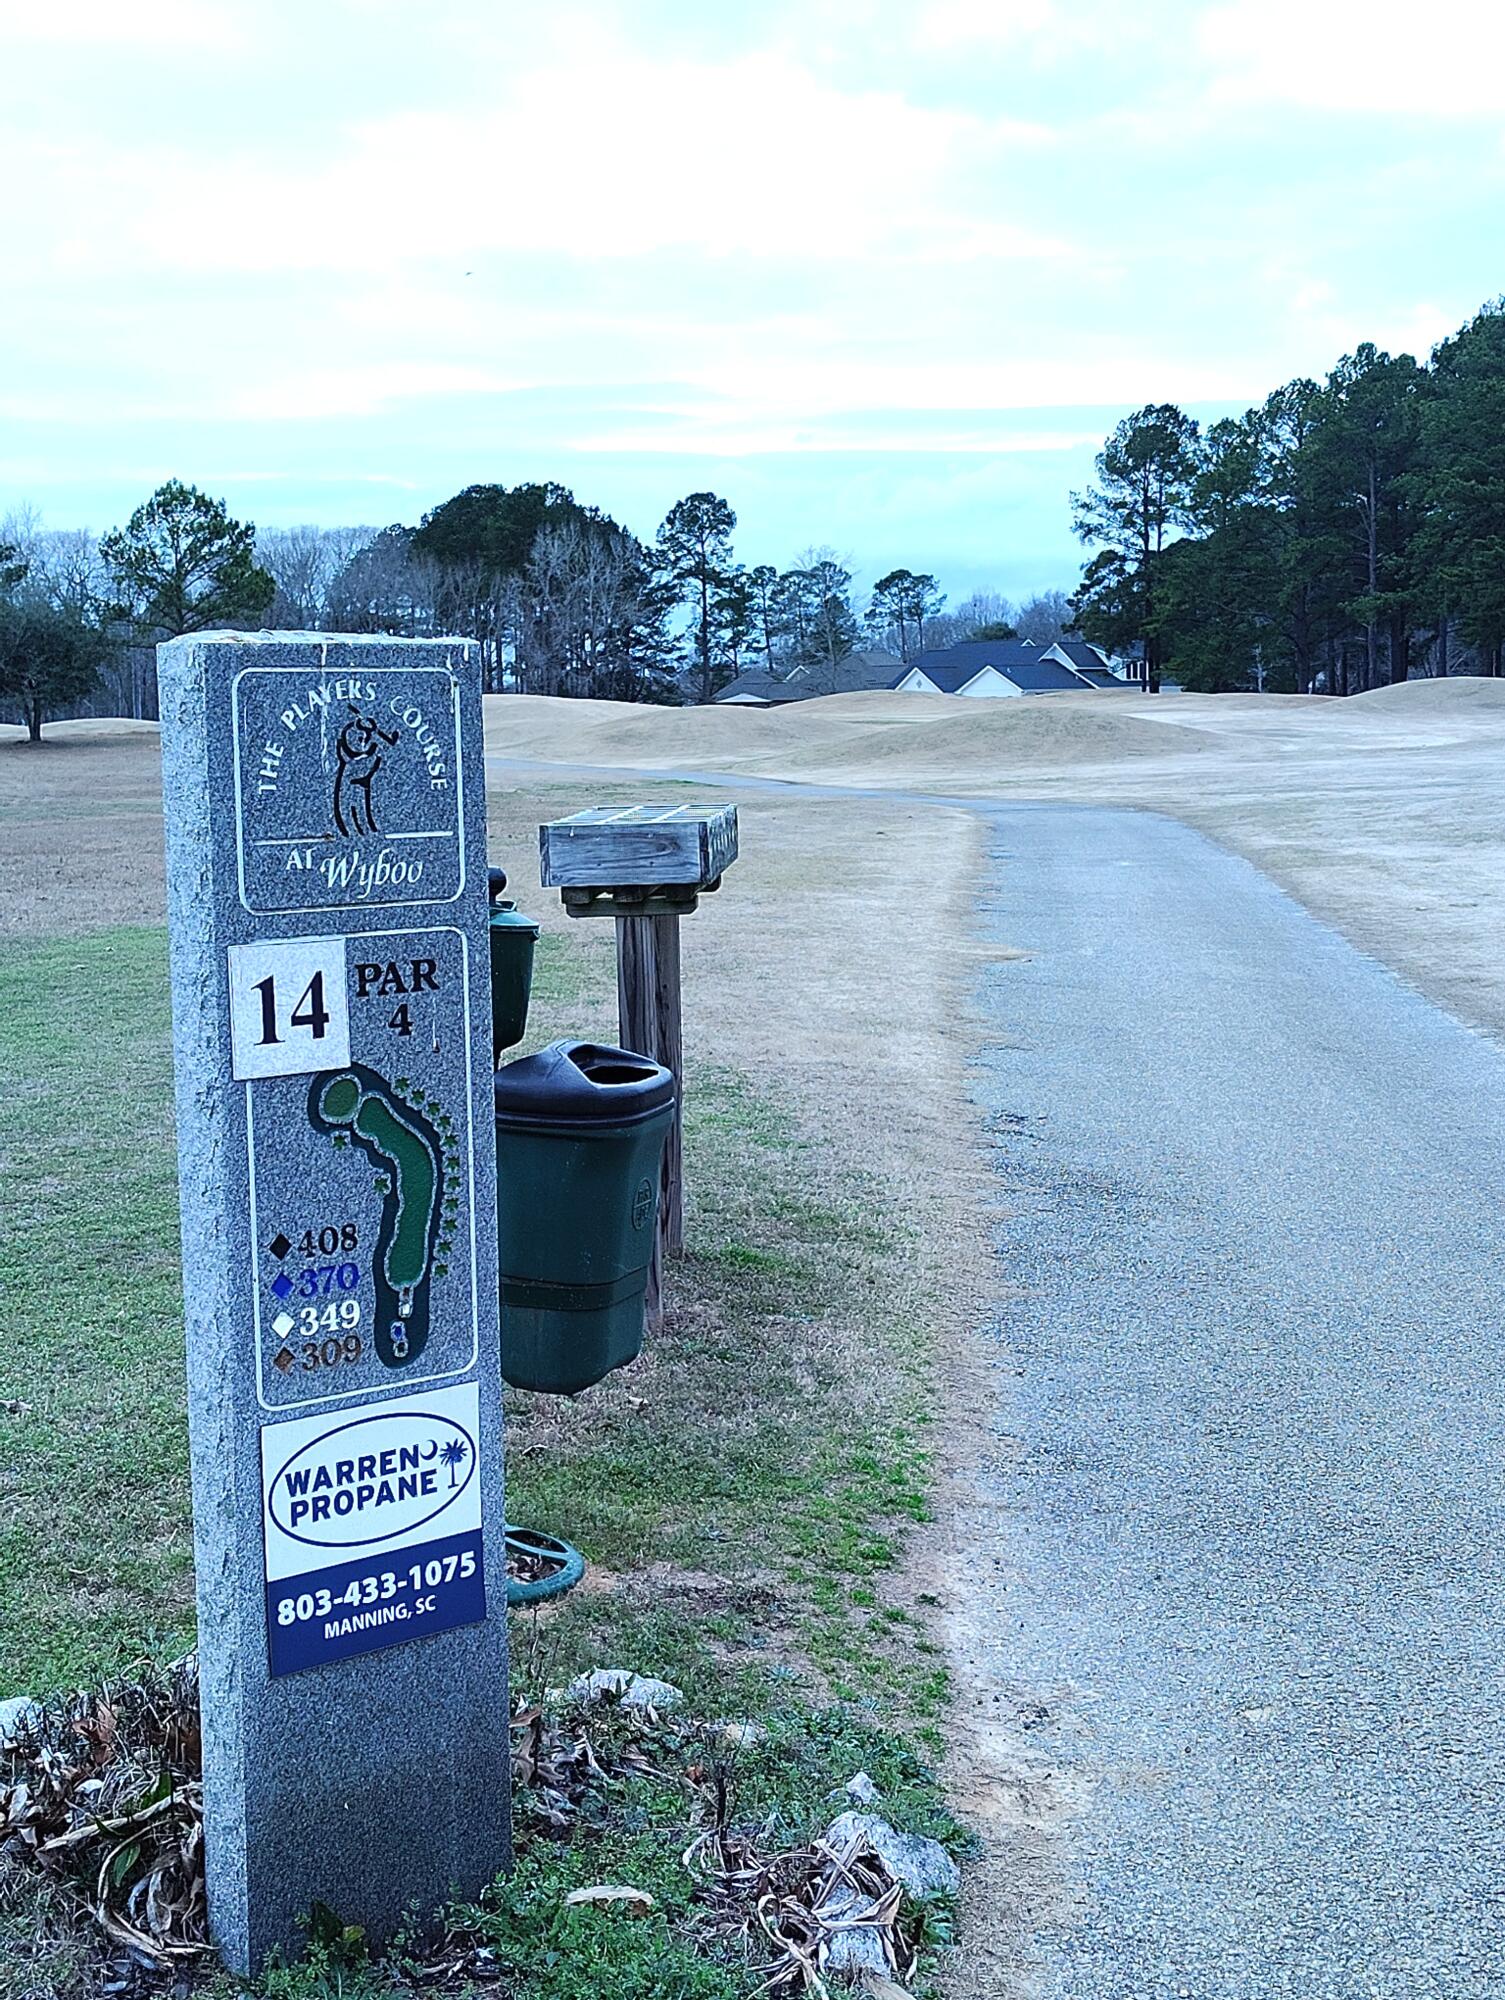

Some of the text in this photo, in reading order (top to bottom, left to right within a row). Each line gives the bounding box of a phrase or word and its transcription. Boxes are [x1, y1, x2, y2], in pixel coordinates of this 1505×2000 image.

[259, 679, 448, 794] THE PLAYERS COURSE
[286, 849, 423, 898] AT Wyboo
[355, 958, 440, 998] PAR
[250, 970, 330, 1046] 14
[388, 1003, 413, 1036] 4
[300, 1222, 359, 1258] 408
[300, 1262, 360, 1298] 370
[300, 1299, 361, 1336] 349
[302, 1334, 362, 1371] 309
[285, 1444, 420, 1498] WARREN
[290, 1469, 438, 1527] PROPANE
[277, 1550, 477, 1626] 803-433-1075
[324, 1595, 436, 1639] MANNING, SC
